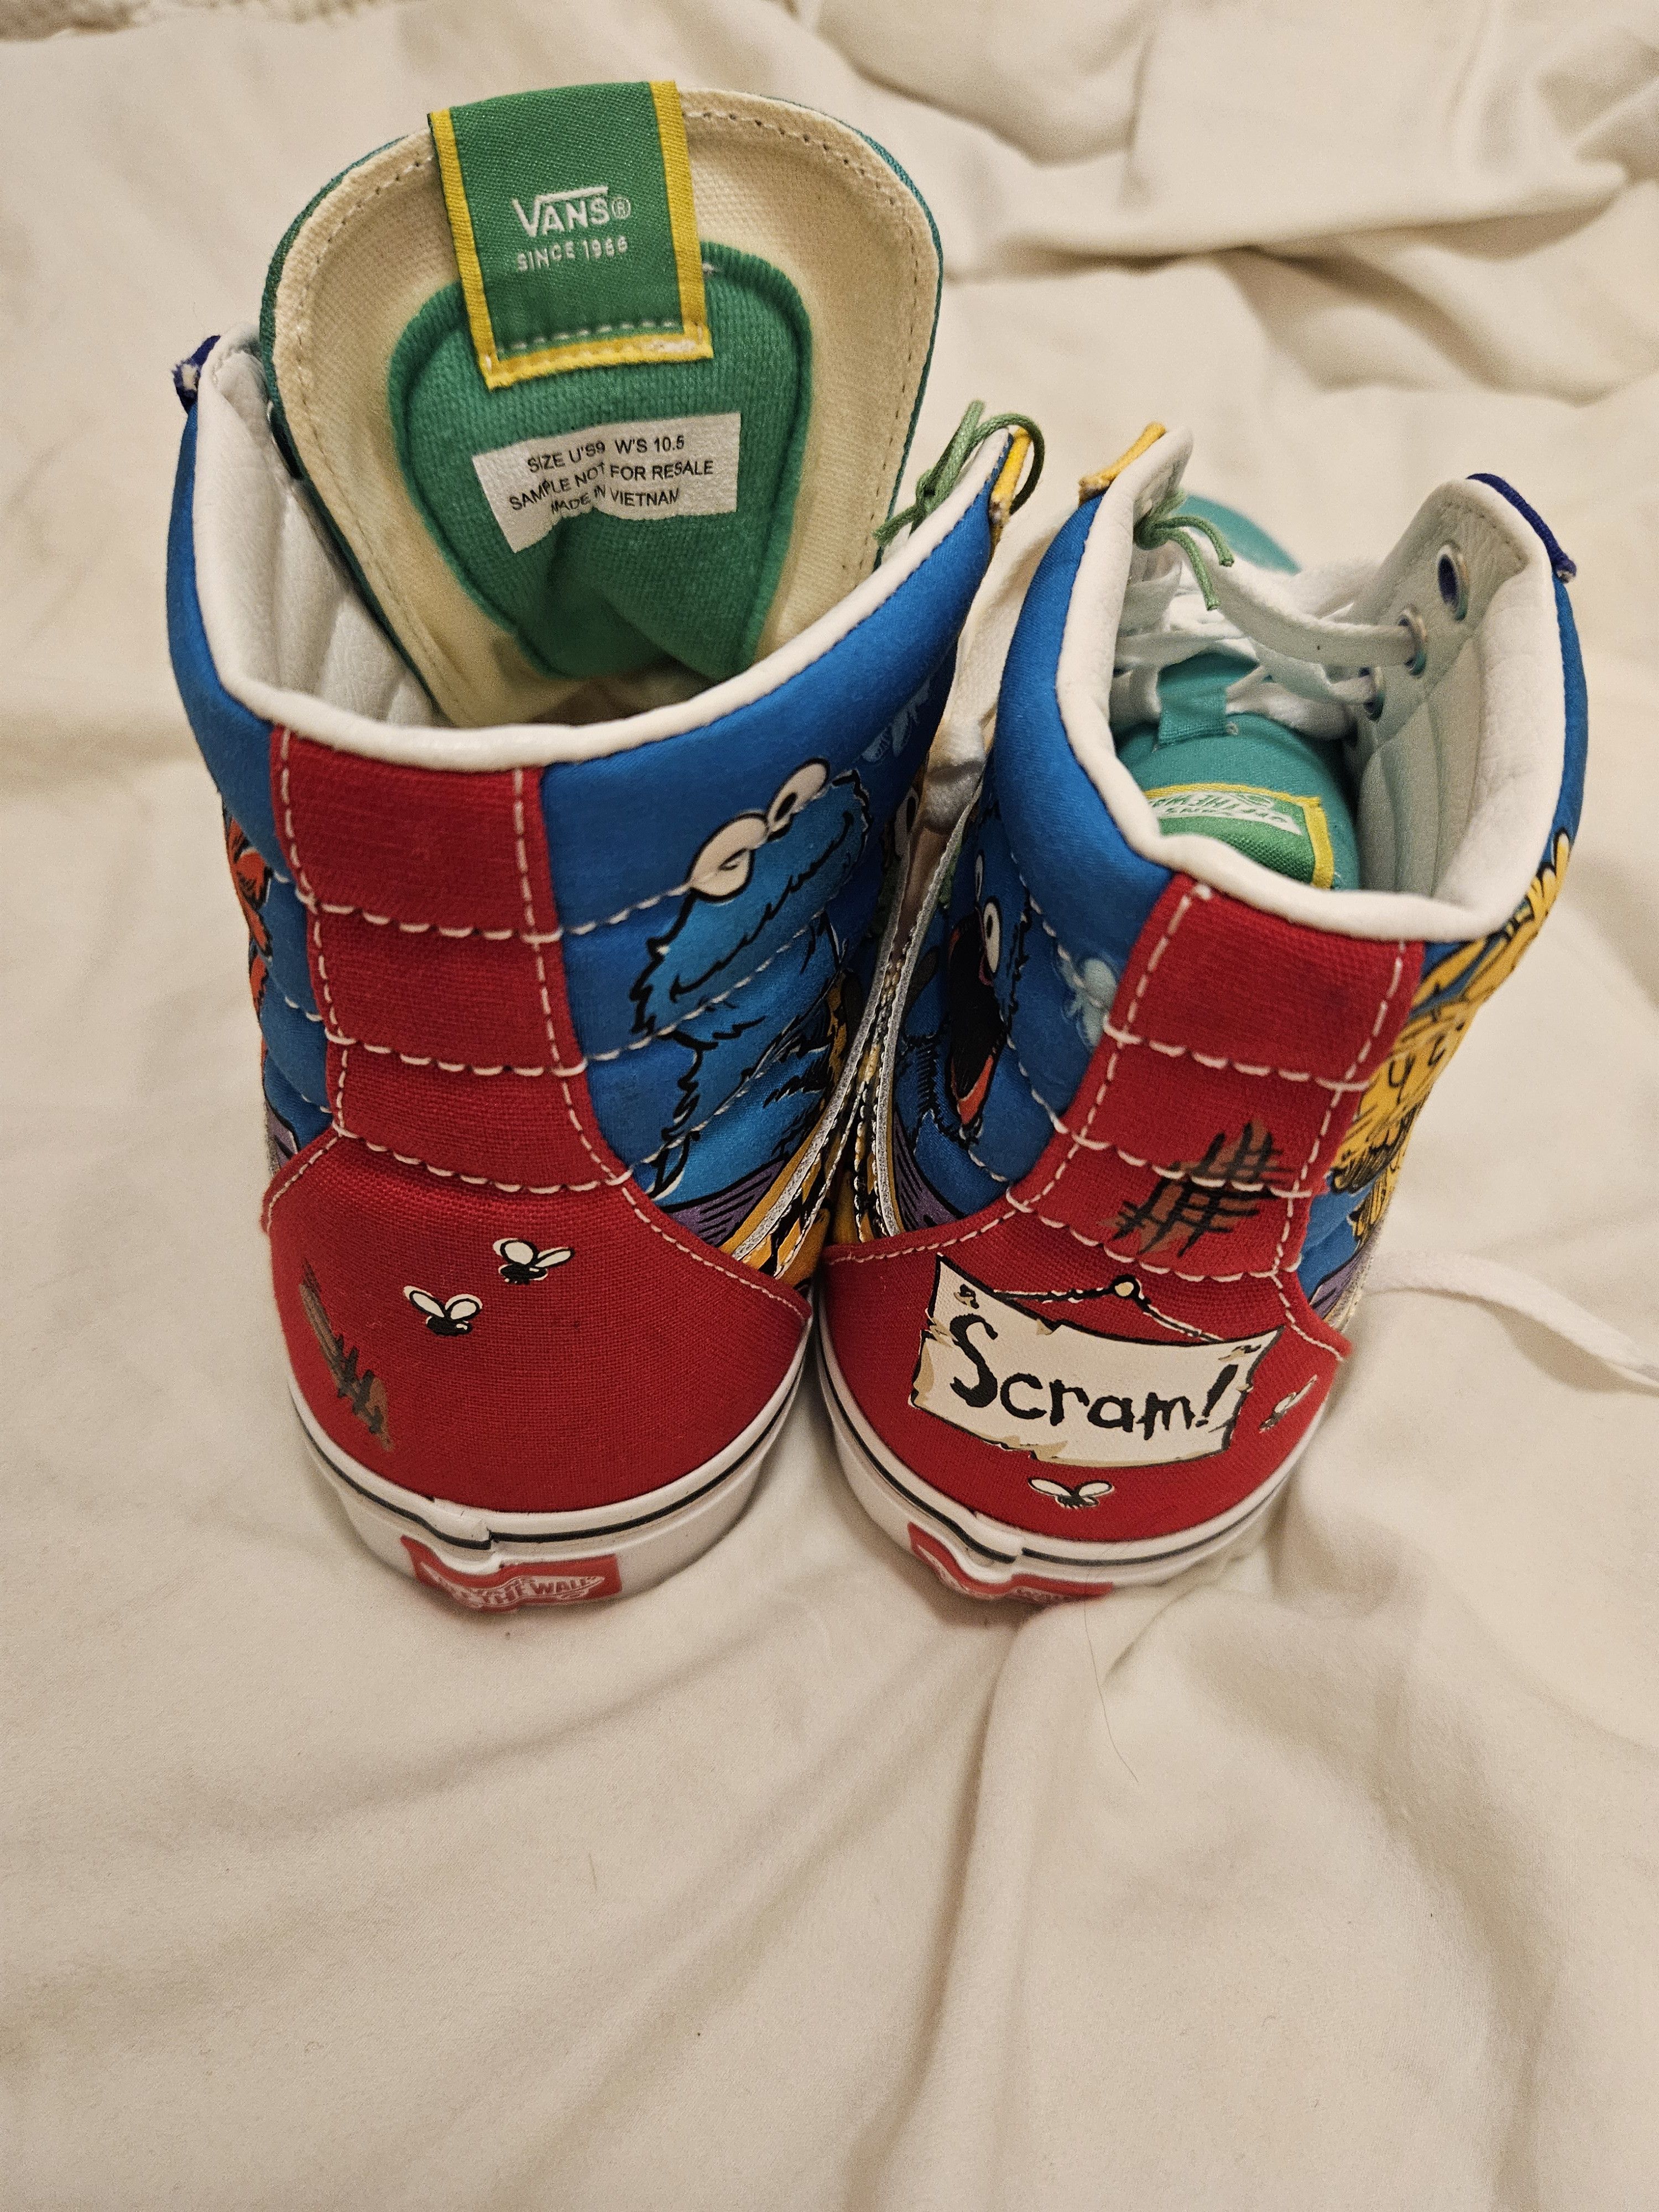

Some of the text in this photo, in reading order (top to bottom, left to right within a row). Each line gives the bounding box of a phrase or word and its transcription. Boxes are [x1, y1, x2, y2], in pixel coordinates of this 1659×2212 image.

[517, 235, 628, 272] SINCE 1966
[527, 451, 565, 473] SIZE
[615, 437, 648, 455] W'S
[654, 434, 685, 453] 10.5
[509, 460, 713, 510] SAMPLE NOT FOR RESALE
[551, 484, 680, 515] MADE IN VIETNAM
[949, 1313, 1239, 1440] Scram!
